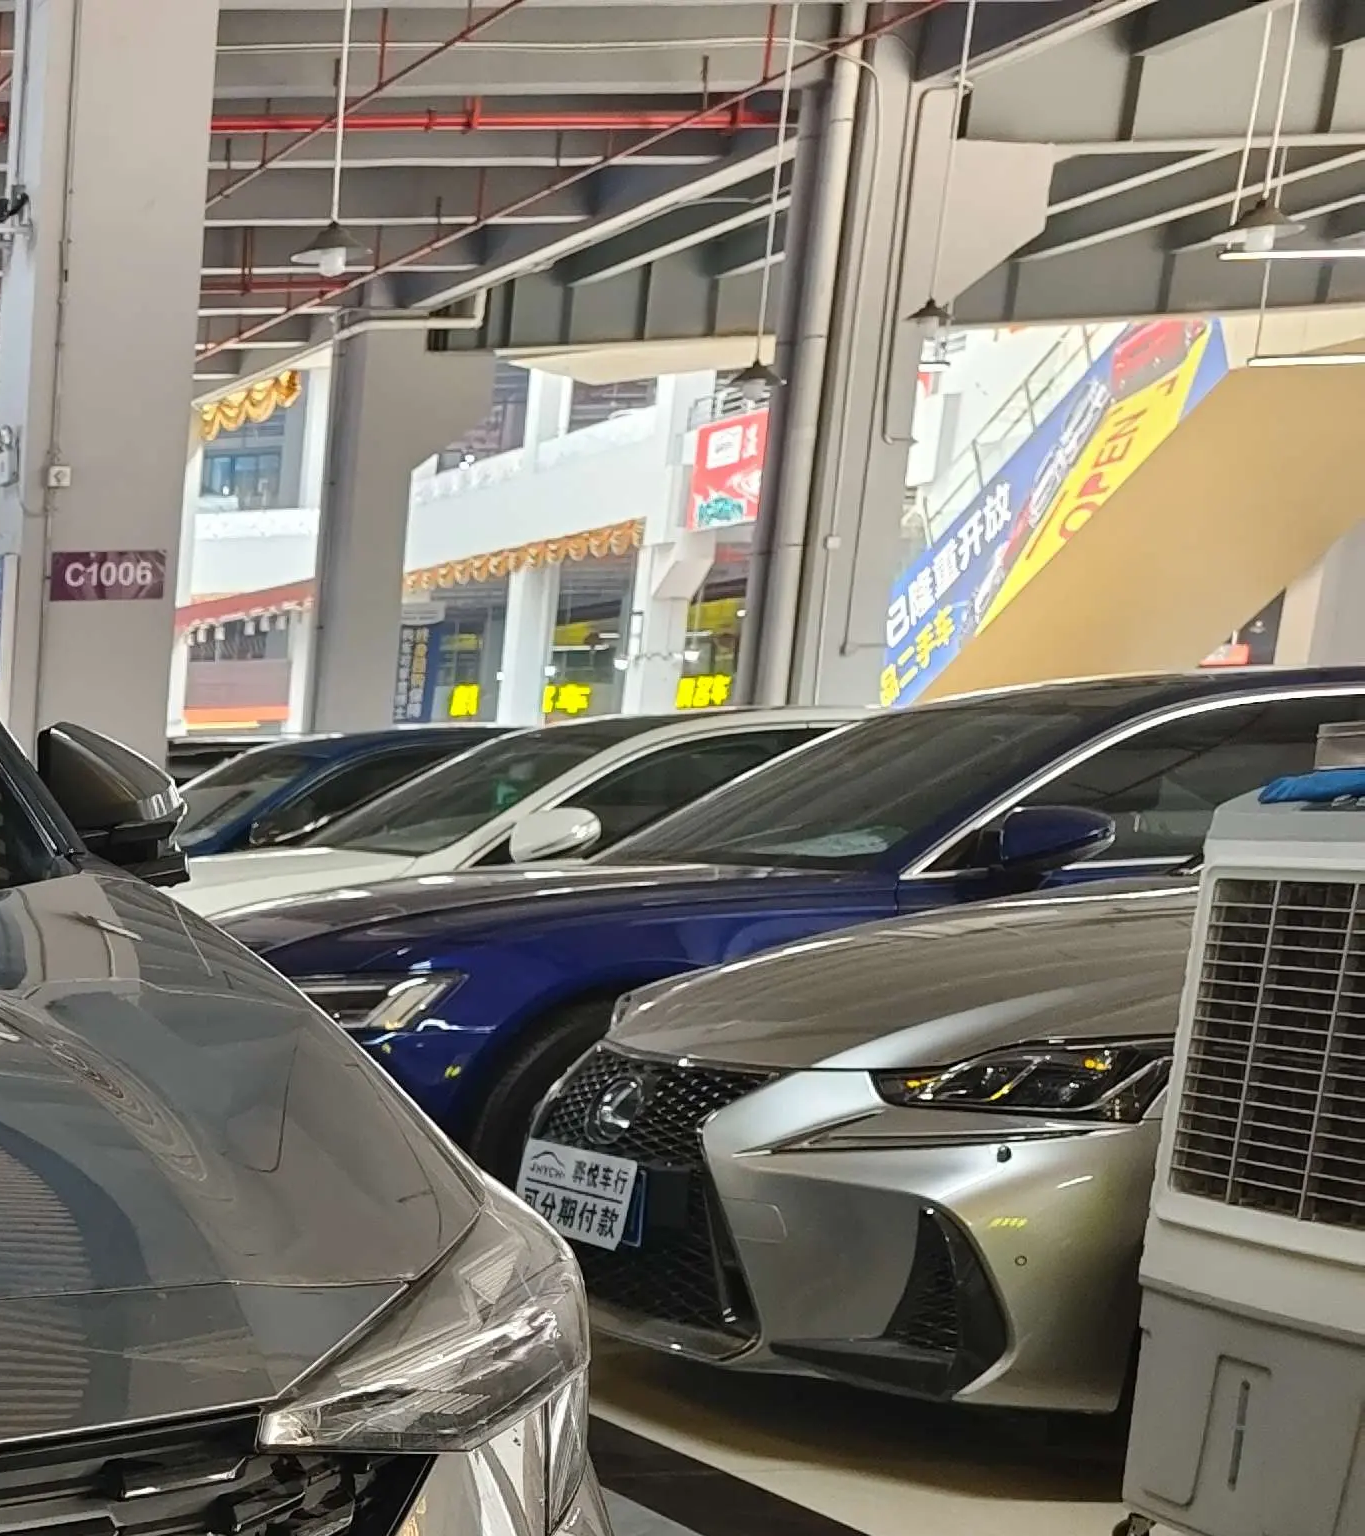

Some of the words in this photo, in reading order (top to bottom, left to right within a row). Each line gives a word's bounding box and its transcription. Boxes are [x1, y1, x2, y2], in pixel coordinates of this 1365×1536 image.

[1060, 406, 1148, 540] OPEN
[65, 562, 152, 588] C1006
[525, 1187, 620, 1239] 可分期付款
